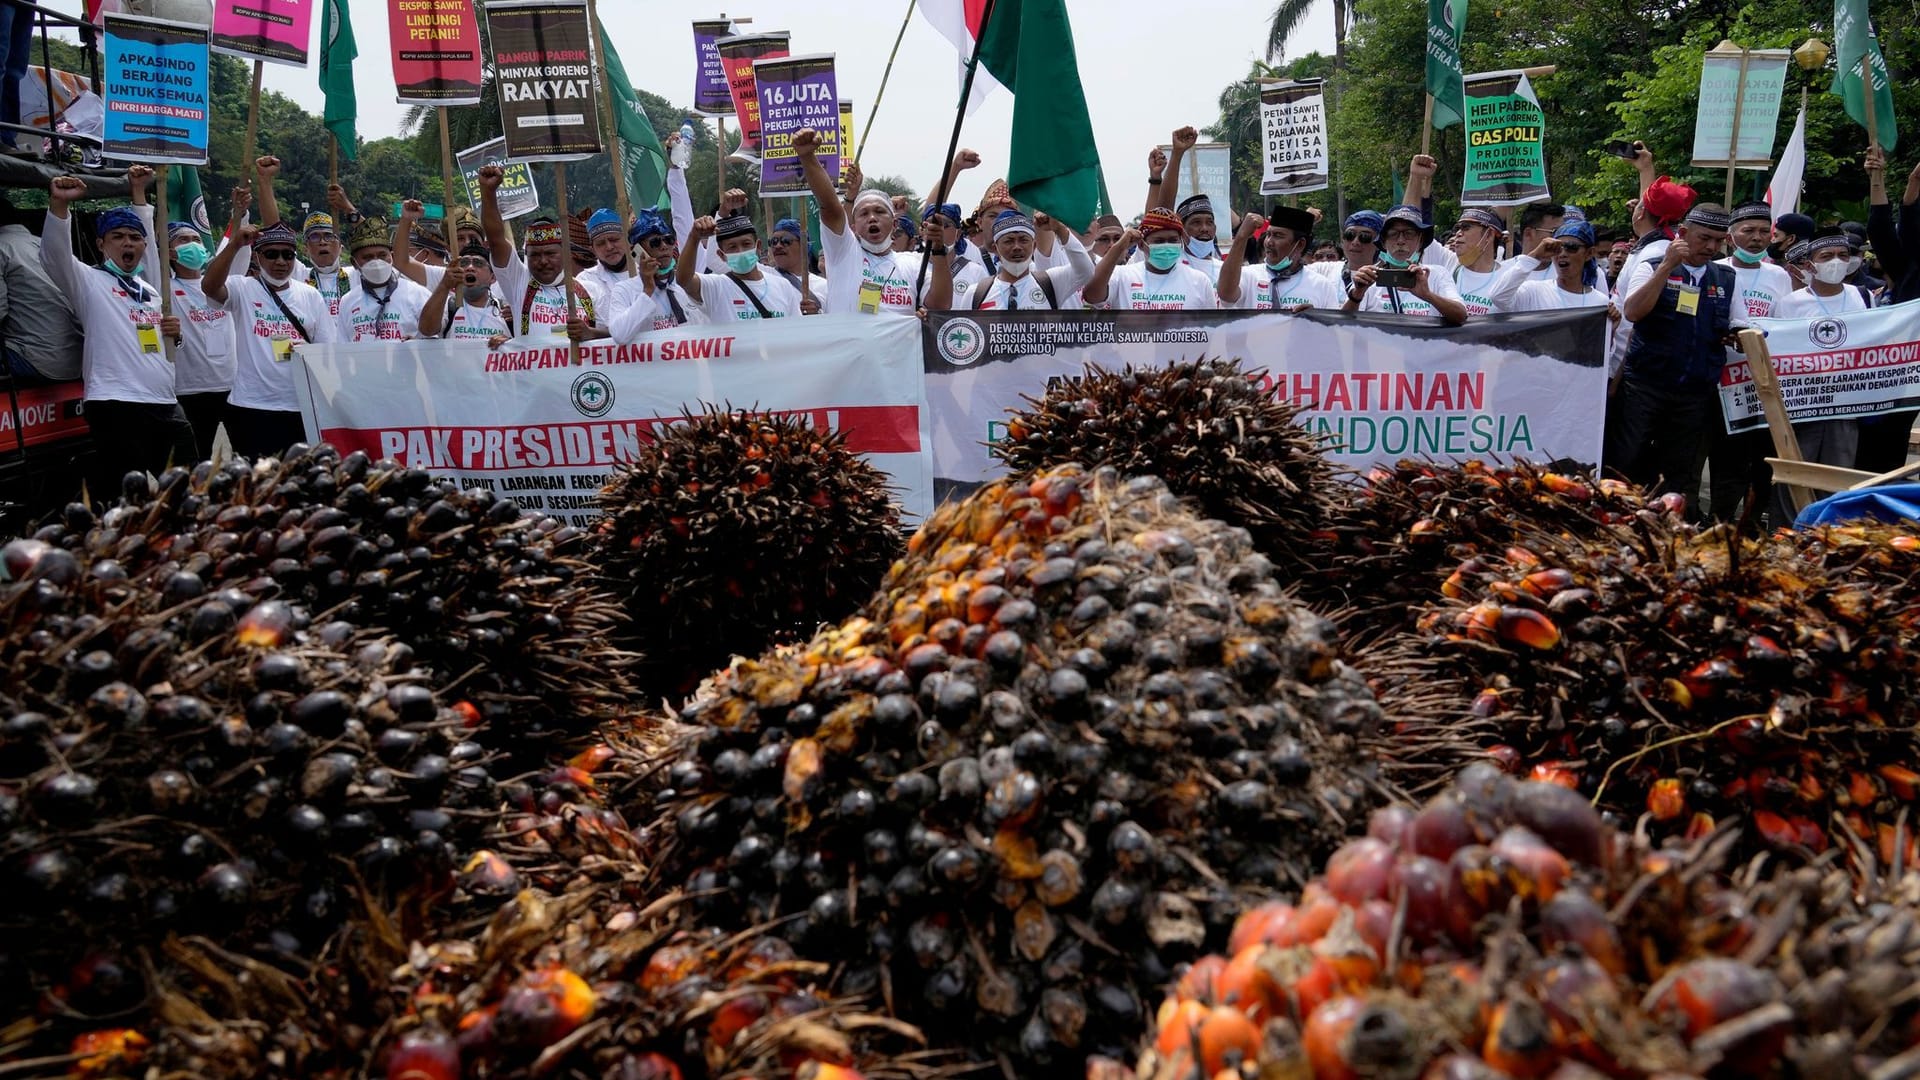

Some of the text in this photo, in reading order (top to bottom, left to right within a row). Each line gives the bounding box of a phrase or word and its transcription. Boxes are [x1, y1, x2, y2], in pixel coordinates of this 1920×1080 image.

[399, 0, 466, 11] EKSPOR SAWIT,
[406, 14, 461, 27] LINDUNGI
[410, 28, 460, 40] PETANI!!
[118, 52, 196, 72] APKASINDO
[497, 50, 588, 64] BANGUN PABRIK
[122, 69, 193, 87] BERJUANG
[500, 65, 589, 80] MINYAK GORENG
[109, 83, 204, 105] UNTUK SEMUA
[503, 80, 590, 103] RAKYAT
[764, 83, 832, 105] 16 JUTA
[111, 101, 202, 119] (NKRI HARGA MATI)
[768, 104, 829, 119] PETANI DAN
[1264, 104, 1320, 118] PETANI SAWIT
[1471, 103, 1496, 116] HEII
[764, 116, 836, 132] PEKERJA SAWIT
[1267, 114, 1319, 128] ADALAH
[1470, 113, 1540, 127] MINYAK GORENG,
[1268, 124, 1320, 139] PAHLAWAN
[1471, 127, 1538, 146] GAS POLL
[1270, 135, 1322, 151] DEVISA
[1270, 148, 1322, 163] NEGARA
[1476, 146, 1533, 159] PRODUKSI
[1470, 158, 1539, 171] MINYAK CURAH
[466, 167, 480, 179] PA
[989, 322, 1115, 333] DEWAN PIMPINAN PUSAT
[989, 332, 1208, 344] ASOSIASI PETANI KELAPA SAWIT INDONESIA
[484, 336, 736, 373] HARAPAN PETANI SAWIT
[989, 343, 1056, 355] (APKASINDO)
[1731, 343, 1919, 383] PA PRESIDEN JOKOWI
[1804, 375, 1831, 386] CABUT
[1833, 371, 1876, 383] LARANGAN
[1878, 367, 1906, 379] EKSPOR
[1786, 389, 1794, 397] DI
[1795, 386, 1819, 397] JAMBI
[1820, 382, 1866, 394] SESUAIKAN
[1868, 378, 1899, 390] DENGAN
[1735, 398, 1743, 407] 2.
[1809, 395, 1834, 406] JAMBI
[1819, 407, 1834, 415] KAB
[1835, 404, 1875, 414] MERANGIN
[1305, 414, 1534, 455] INDONESIA
[380, 429, 456, 469] PAK
[462, 422, 640, 470] PRESIDEN
[461, 478, 496, 492] CABUT
[500, 475, 566, 491] LARANGAN
